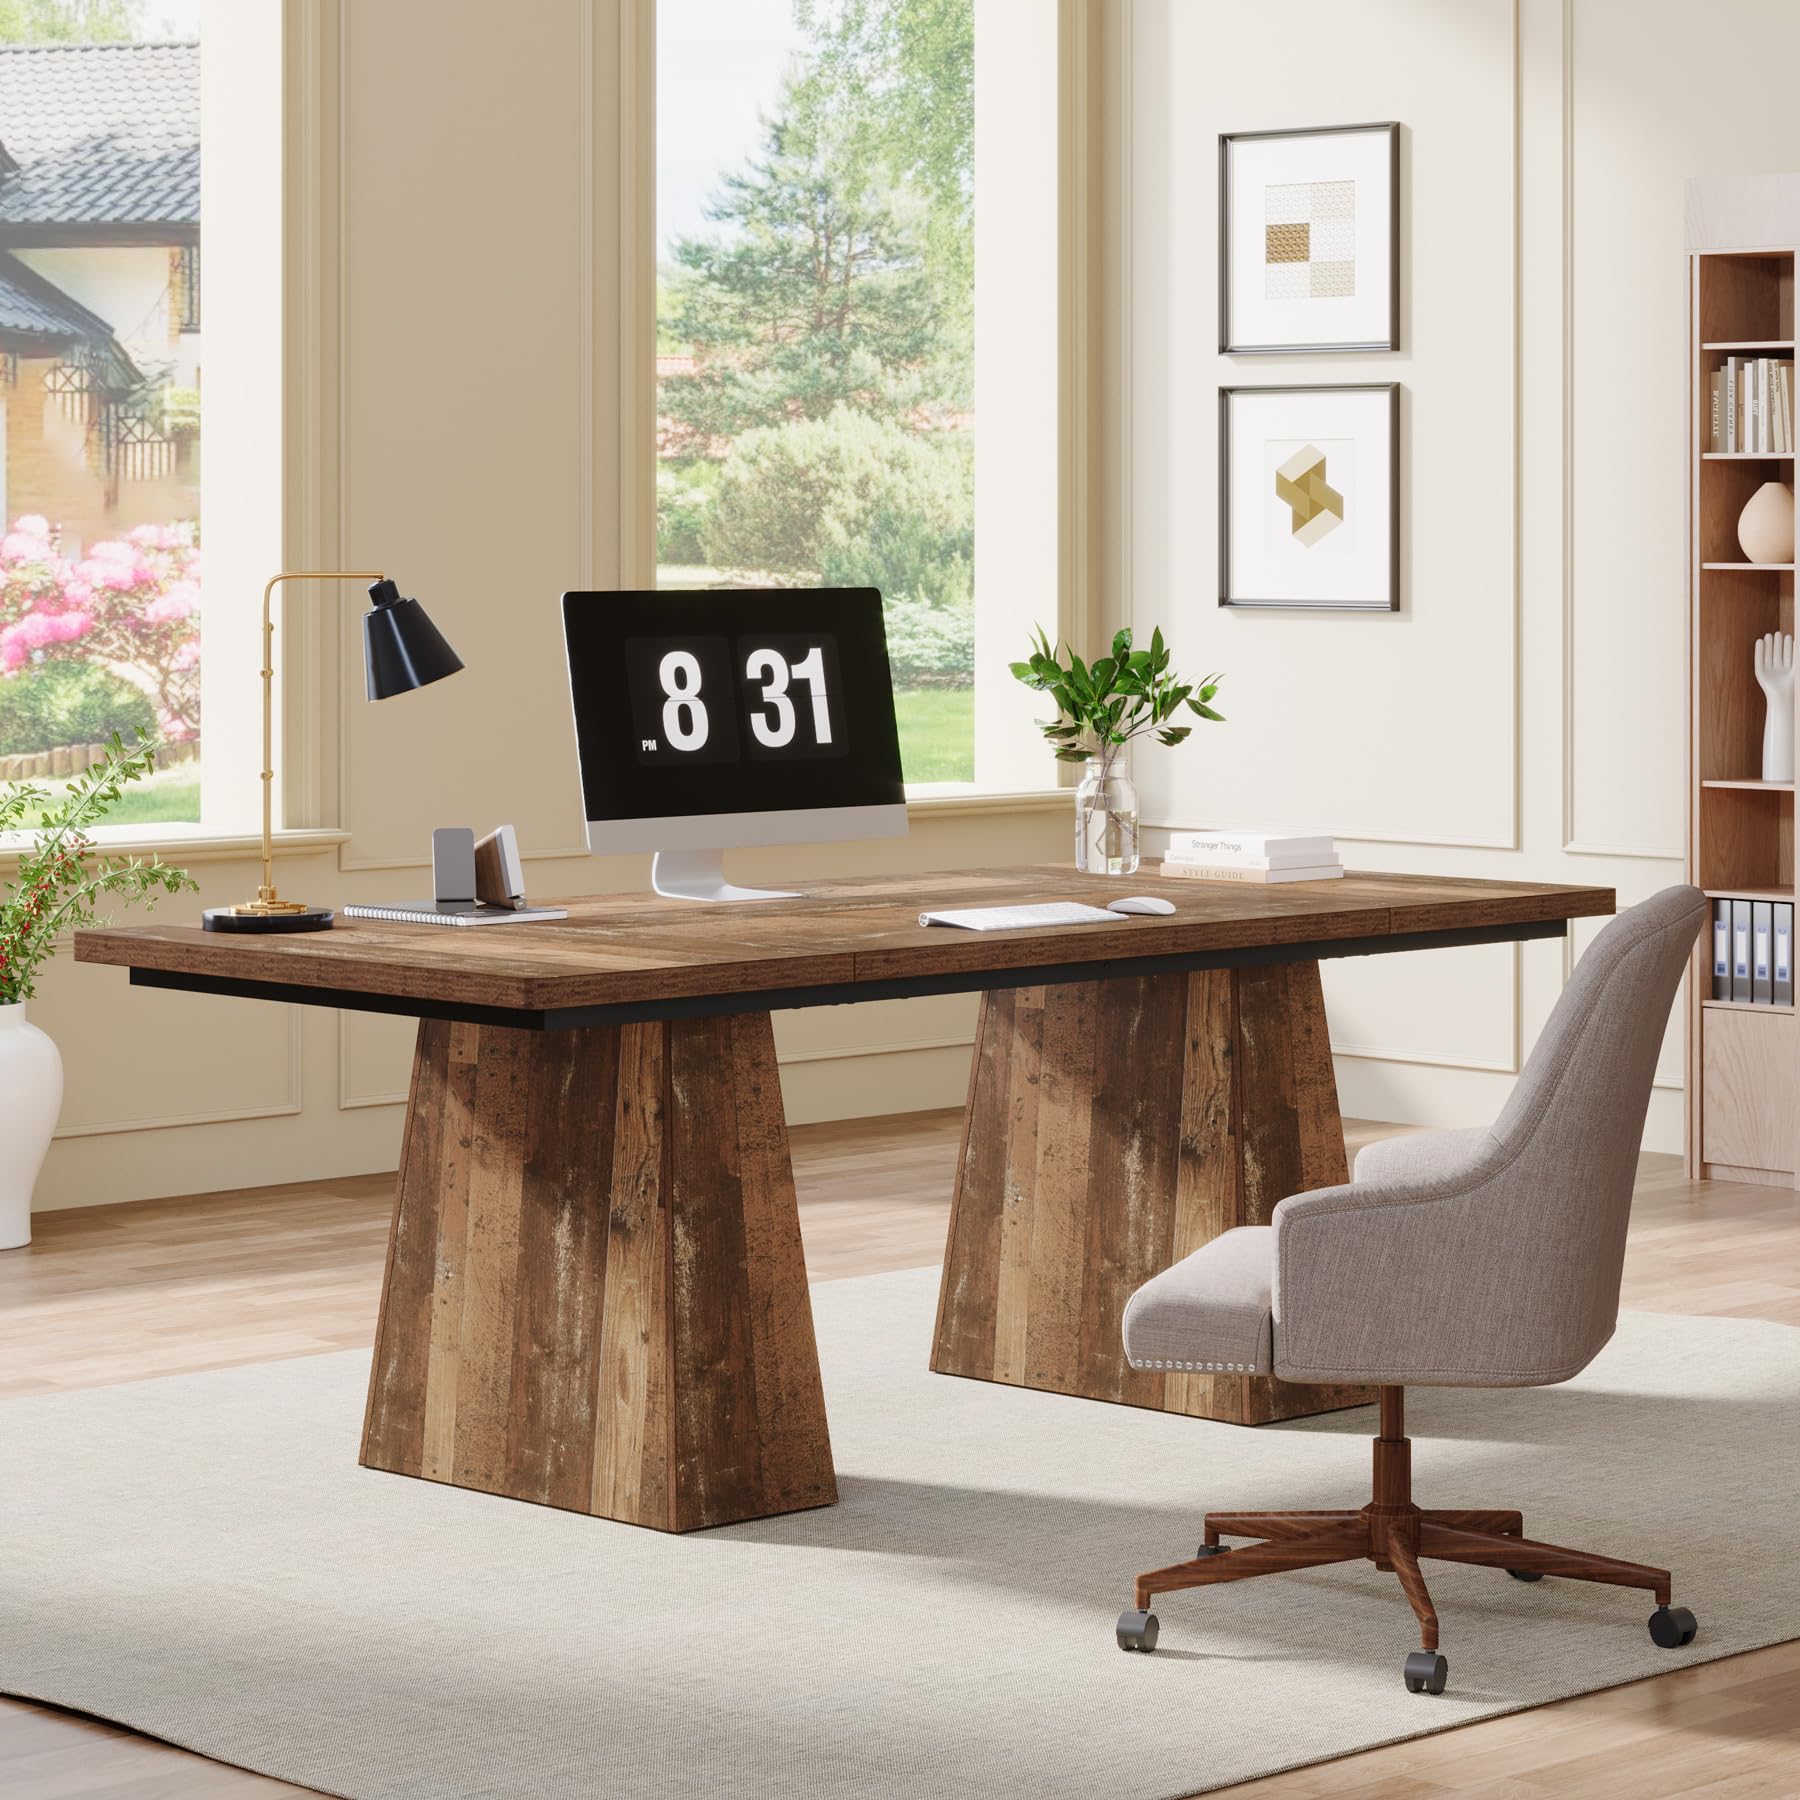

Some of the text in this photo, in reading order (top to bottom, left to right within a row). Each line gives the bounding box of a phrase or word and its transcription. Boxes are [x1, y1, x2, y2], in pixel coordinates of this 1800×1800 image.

[641, 647, 833, 751] PM 8 31
[1191, 839, 1242, 853] Stranger Things
[1183, 869, 1245, 880] STYLE GUIDE
